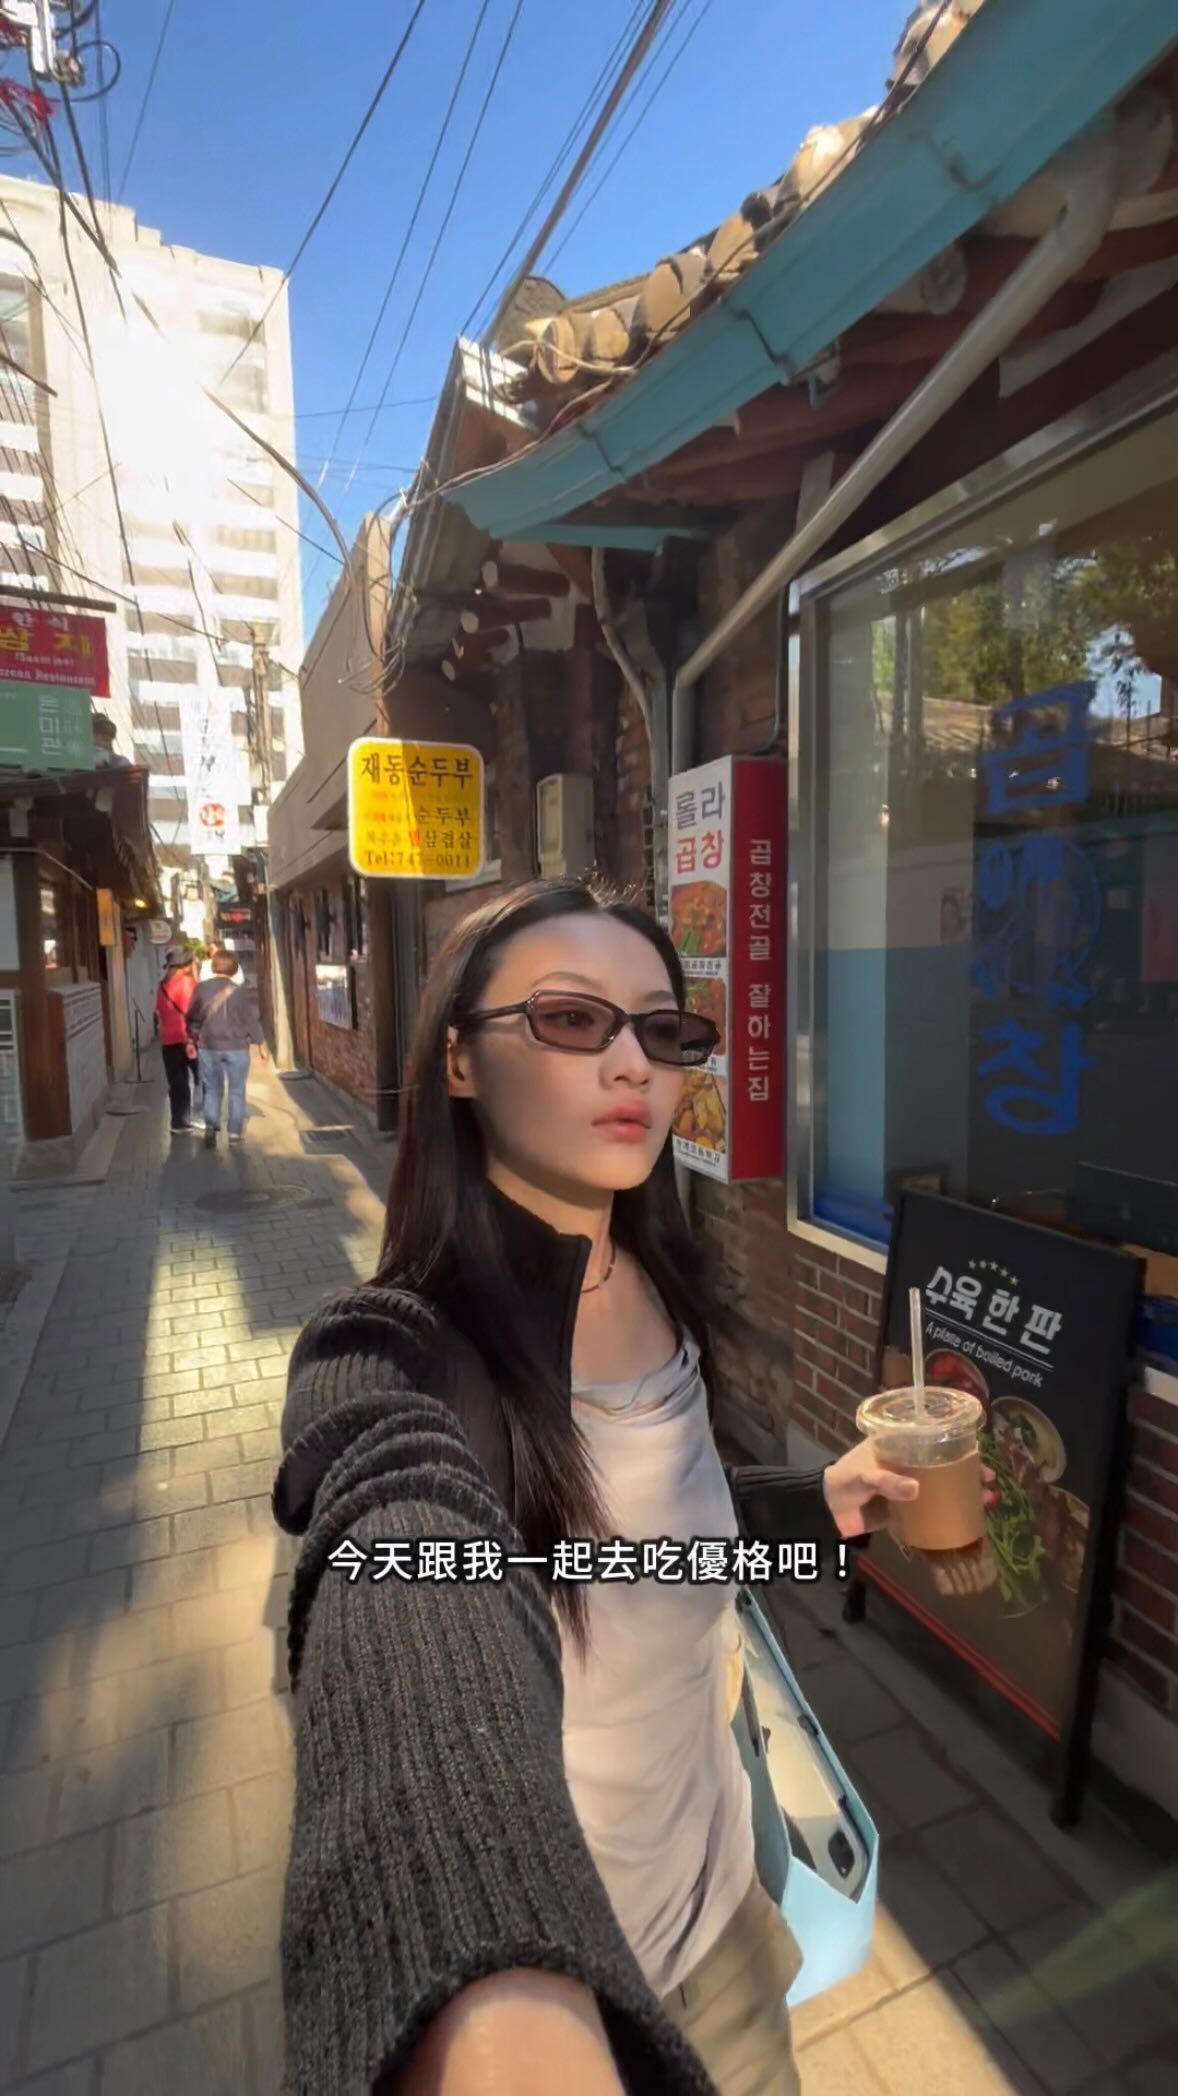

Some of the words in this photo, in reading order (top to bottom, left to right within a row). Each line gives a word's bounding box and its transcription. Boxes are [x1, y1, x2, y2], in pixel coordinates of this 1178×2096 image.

[361, 752, 472, 789] 재동순두부
[417, 806, 472, 827] 순두부
[675, 830, 725, 875] 곱창
[749, 839, 772, 960] 곱창전골
[748, 984, 771, 1102] 잘하는집
[925, 1266, 982, 1321] 수육
[982, 1288, 1020, 1336] 한
[1020, 1304, 1063, 1356] 판
[925, 1321, 934, 1335] A
[932, 1327, 962, 1348] plate
[962, 1341, 977, 1355] of
[975, 1345, 1014, 1373] boiled
[1011, 1364, 1044, 1388] pork
